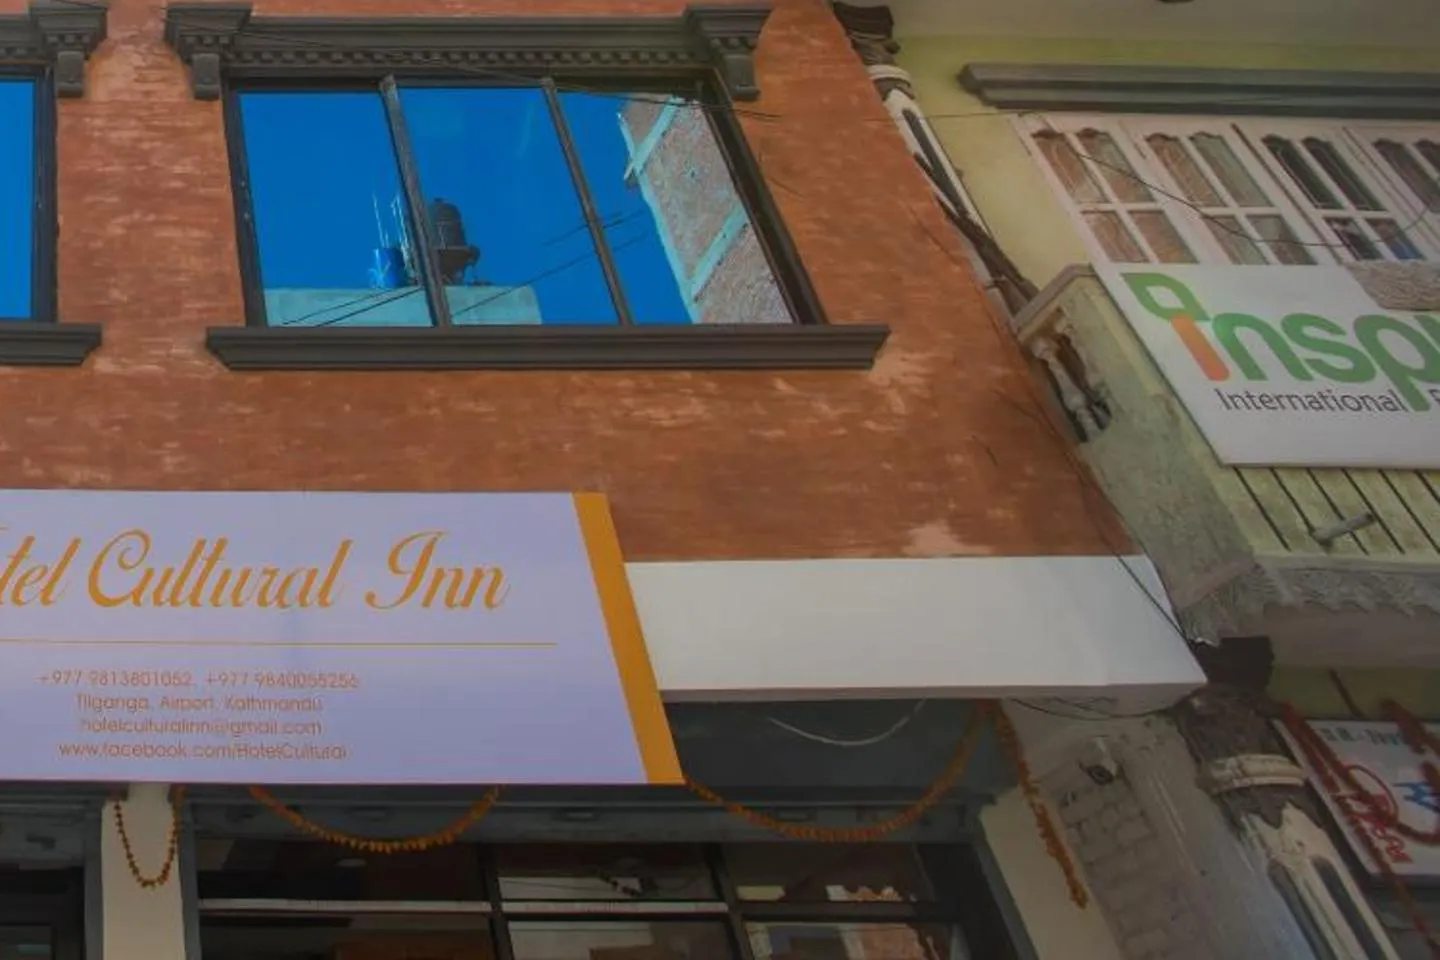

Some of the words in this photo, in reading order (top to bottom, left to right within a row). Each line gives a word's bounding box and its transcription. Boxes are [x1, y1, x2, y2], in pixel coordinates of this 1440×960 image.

[1215, 388, 1408, 412] International
[88, 529, 352, 608] Cultural
[365, 531, 510, 609] Inn
